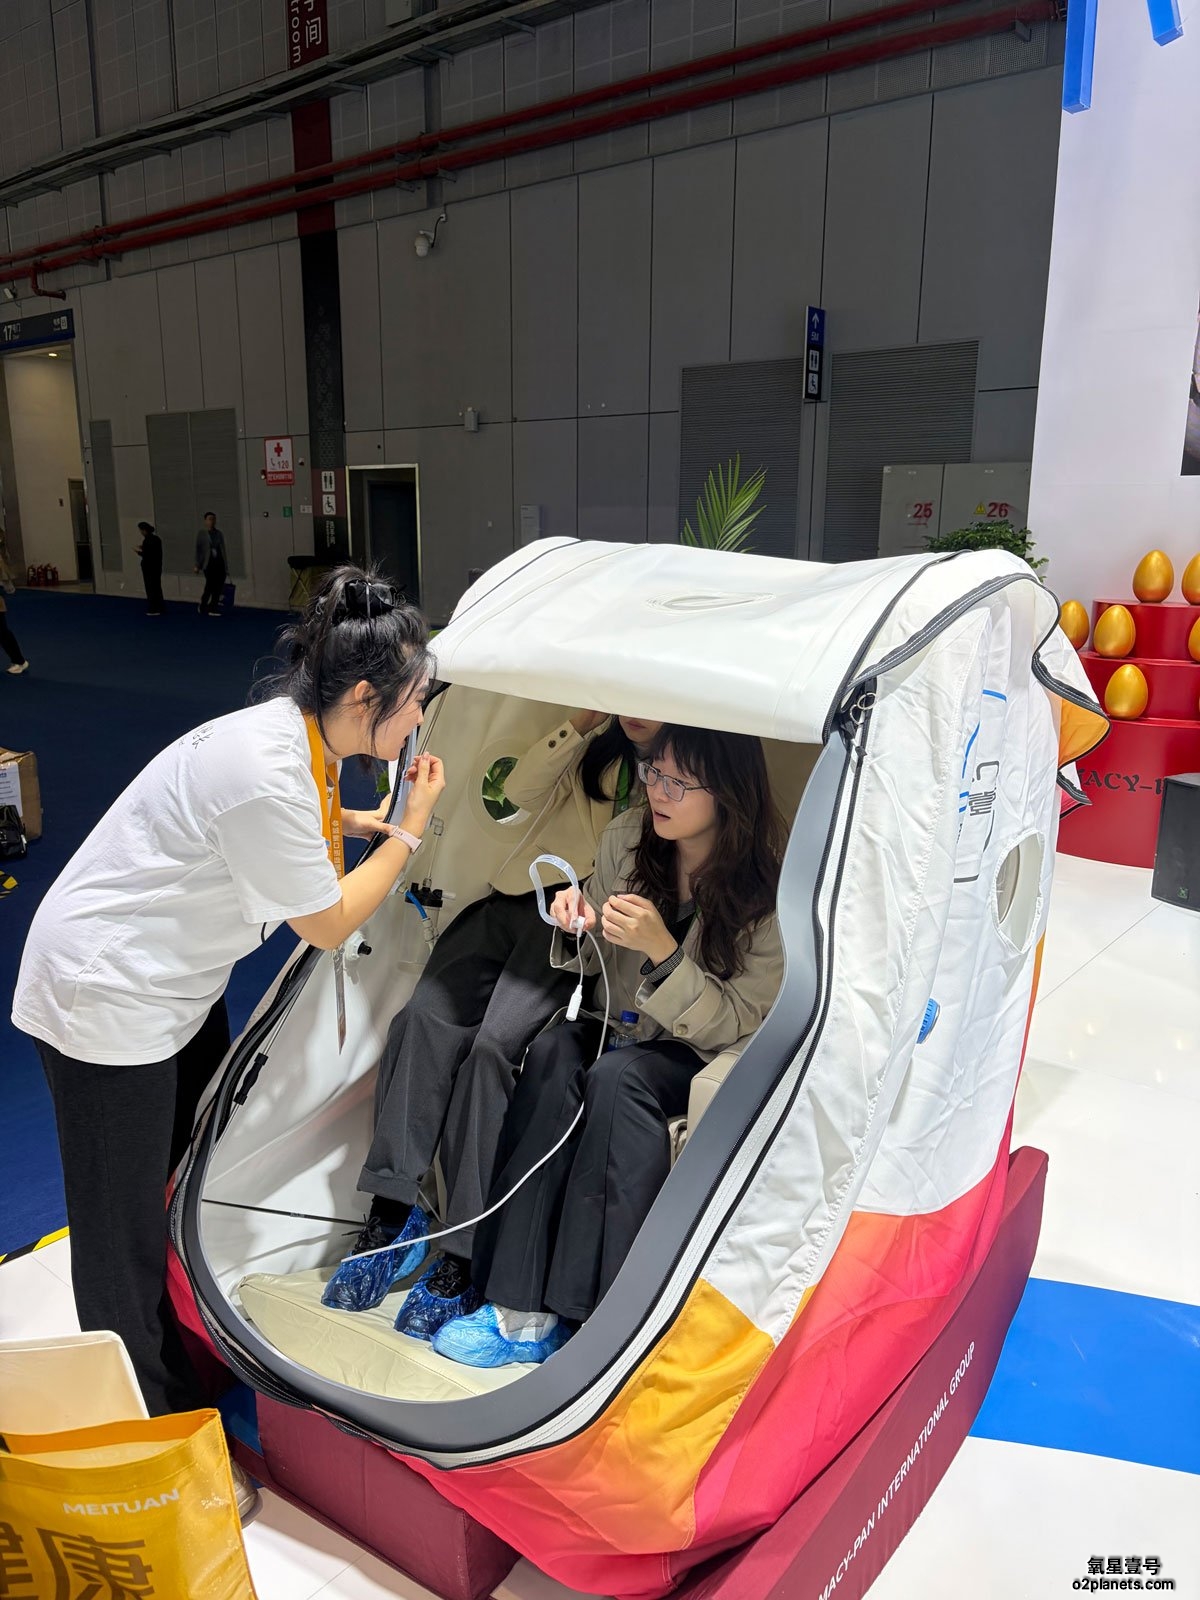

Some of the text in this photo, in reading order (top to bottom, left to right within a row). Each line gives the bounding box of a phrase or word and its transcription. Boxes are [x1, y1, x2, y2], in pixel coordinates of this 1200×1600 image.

[277, 459, 289, 469] 120
[913, 502, 933, 519] 25
[986, 501, 1009, 518] 26
[877, 1391, 950, 1520] INTERNATIONAL
[949, 1341, 975, 1395] GROUP
[62, 1487, 180, 1516] MEITUAN
